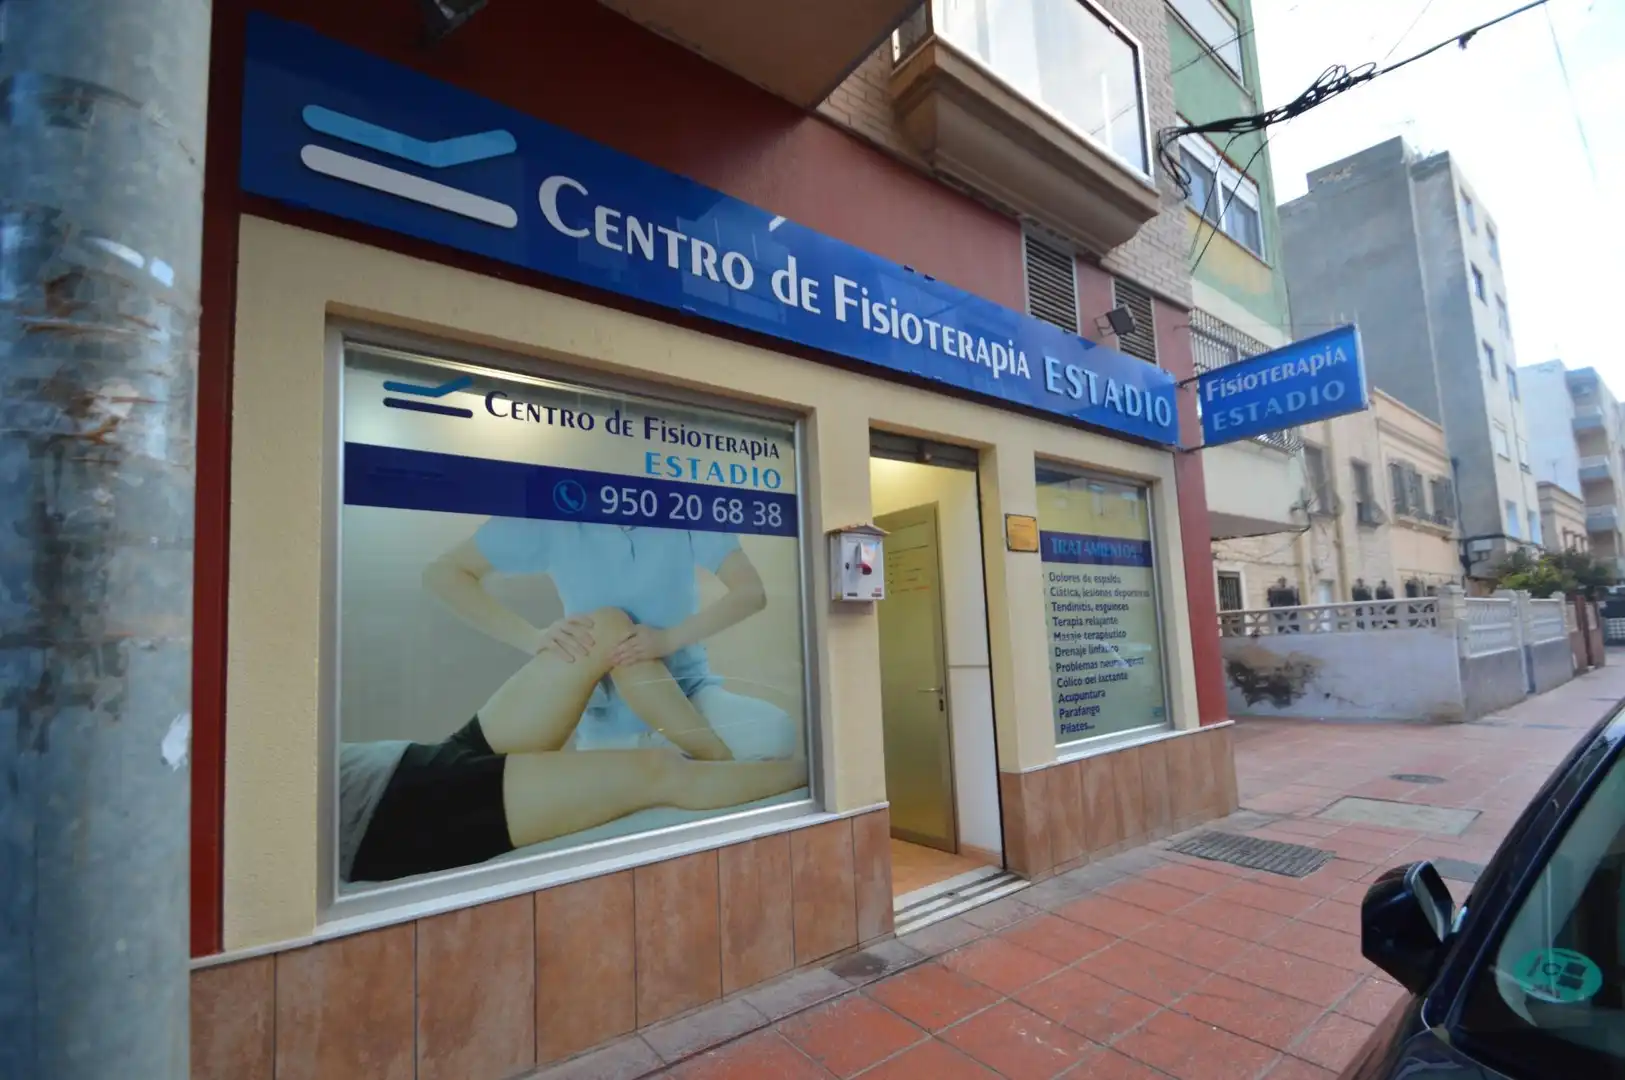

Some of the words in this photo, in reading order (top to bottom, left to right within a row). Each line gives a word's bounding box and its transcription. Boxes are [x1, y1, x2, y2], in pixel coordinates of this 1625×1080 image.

[538, 175, 754, 291] CENTRO
[1044, 355, 1172, 428] ESTADIO
[484, 390, 595, 431] CENTRO
[1212, 380, 1346, 432] ESTADIO
[645, 451, 782, 489] ESTADIO
[600, 485, 658, 518] 950
[668, 492, 703, 521] 20
[712, 497, 745, 525] 68
[752, 501, 782, 528] 38
[1049, 571, 1080, 583] Dolores
[1052, 616, 1083, 628] Terapia
[1085, 615, 1119, 627] relajante
[1053, 631, 1082, 644] Masaje
[1055, 645, 1087, 658] Drenaje
[1055, 659, 1098, 673] Problemas
[1085, 675, 1097, 685] del
[1098, 671, 1129, 683] lactante
[1058, 689, 1107, 705] Acupuntura
[1059, 704, 1101, 719] Parafango
